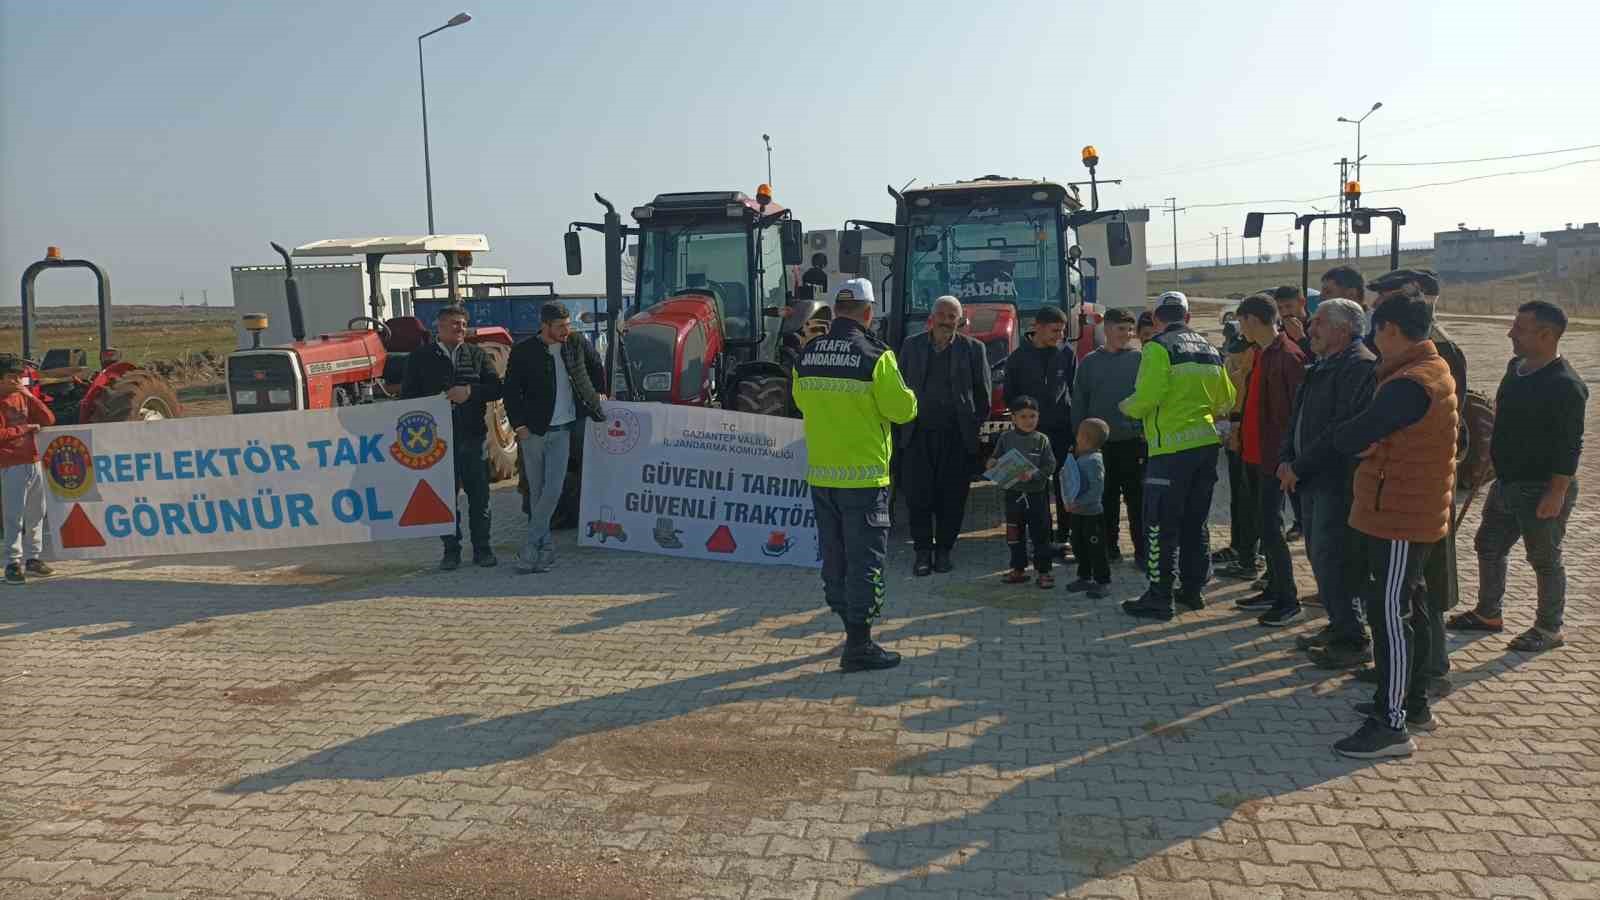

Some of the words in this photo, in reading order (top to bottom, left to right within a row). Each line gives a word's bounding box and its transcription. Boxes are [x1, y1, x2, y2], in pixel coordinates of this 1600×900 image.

[801, 352, 861, 368] JANDARMASI
[815, 339, 853, 351] TRAFİK
[93, 439, 301, 484] REFLEKTÖR
[307, 432, 386, 468] TAK
[641, 461, 735, 493] GÜVENLİ
[741, 472, 809, 499] TARIM
[104, 488, 319, 539] GÖRÜNÜR
[331, 486, 394, 524] OL
[624, 489, 717, 520] GÜVENLİ
[723, 501, 817, 529] TRAKTÖR
